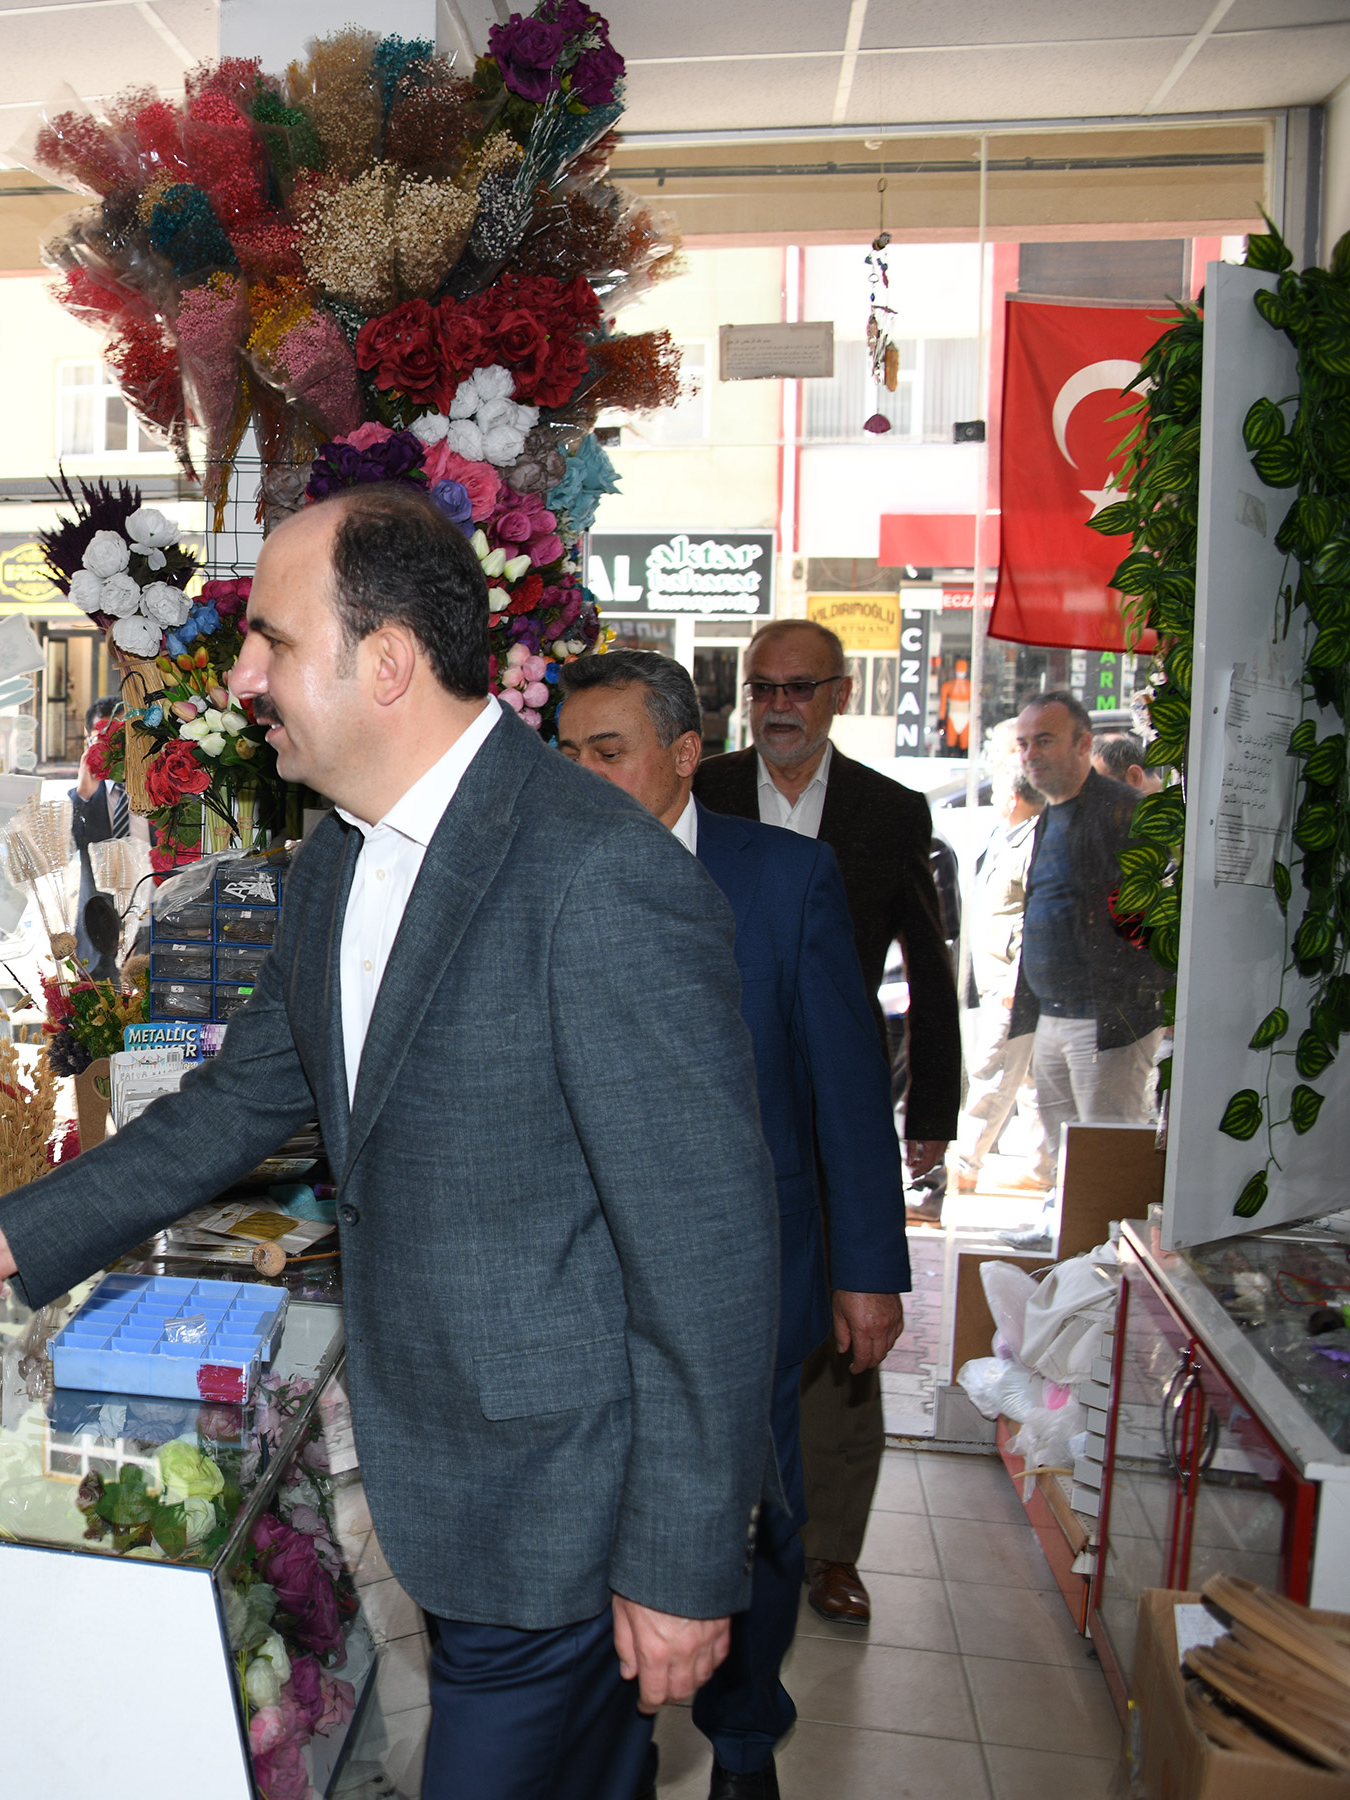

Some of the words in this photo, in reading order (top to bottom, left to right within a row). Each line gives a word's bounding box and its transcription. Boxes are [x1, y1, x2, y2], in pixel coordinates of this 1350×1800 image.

[646, 535, 763, 569] aktar
[647, 567, 762, 593] baharat
[128, 1028, 197, 1044] METALLIC
